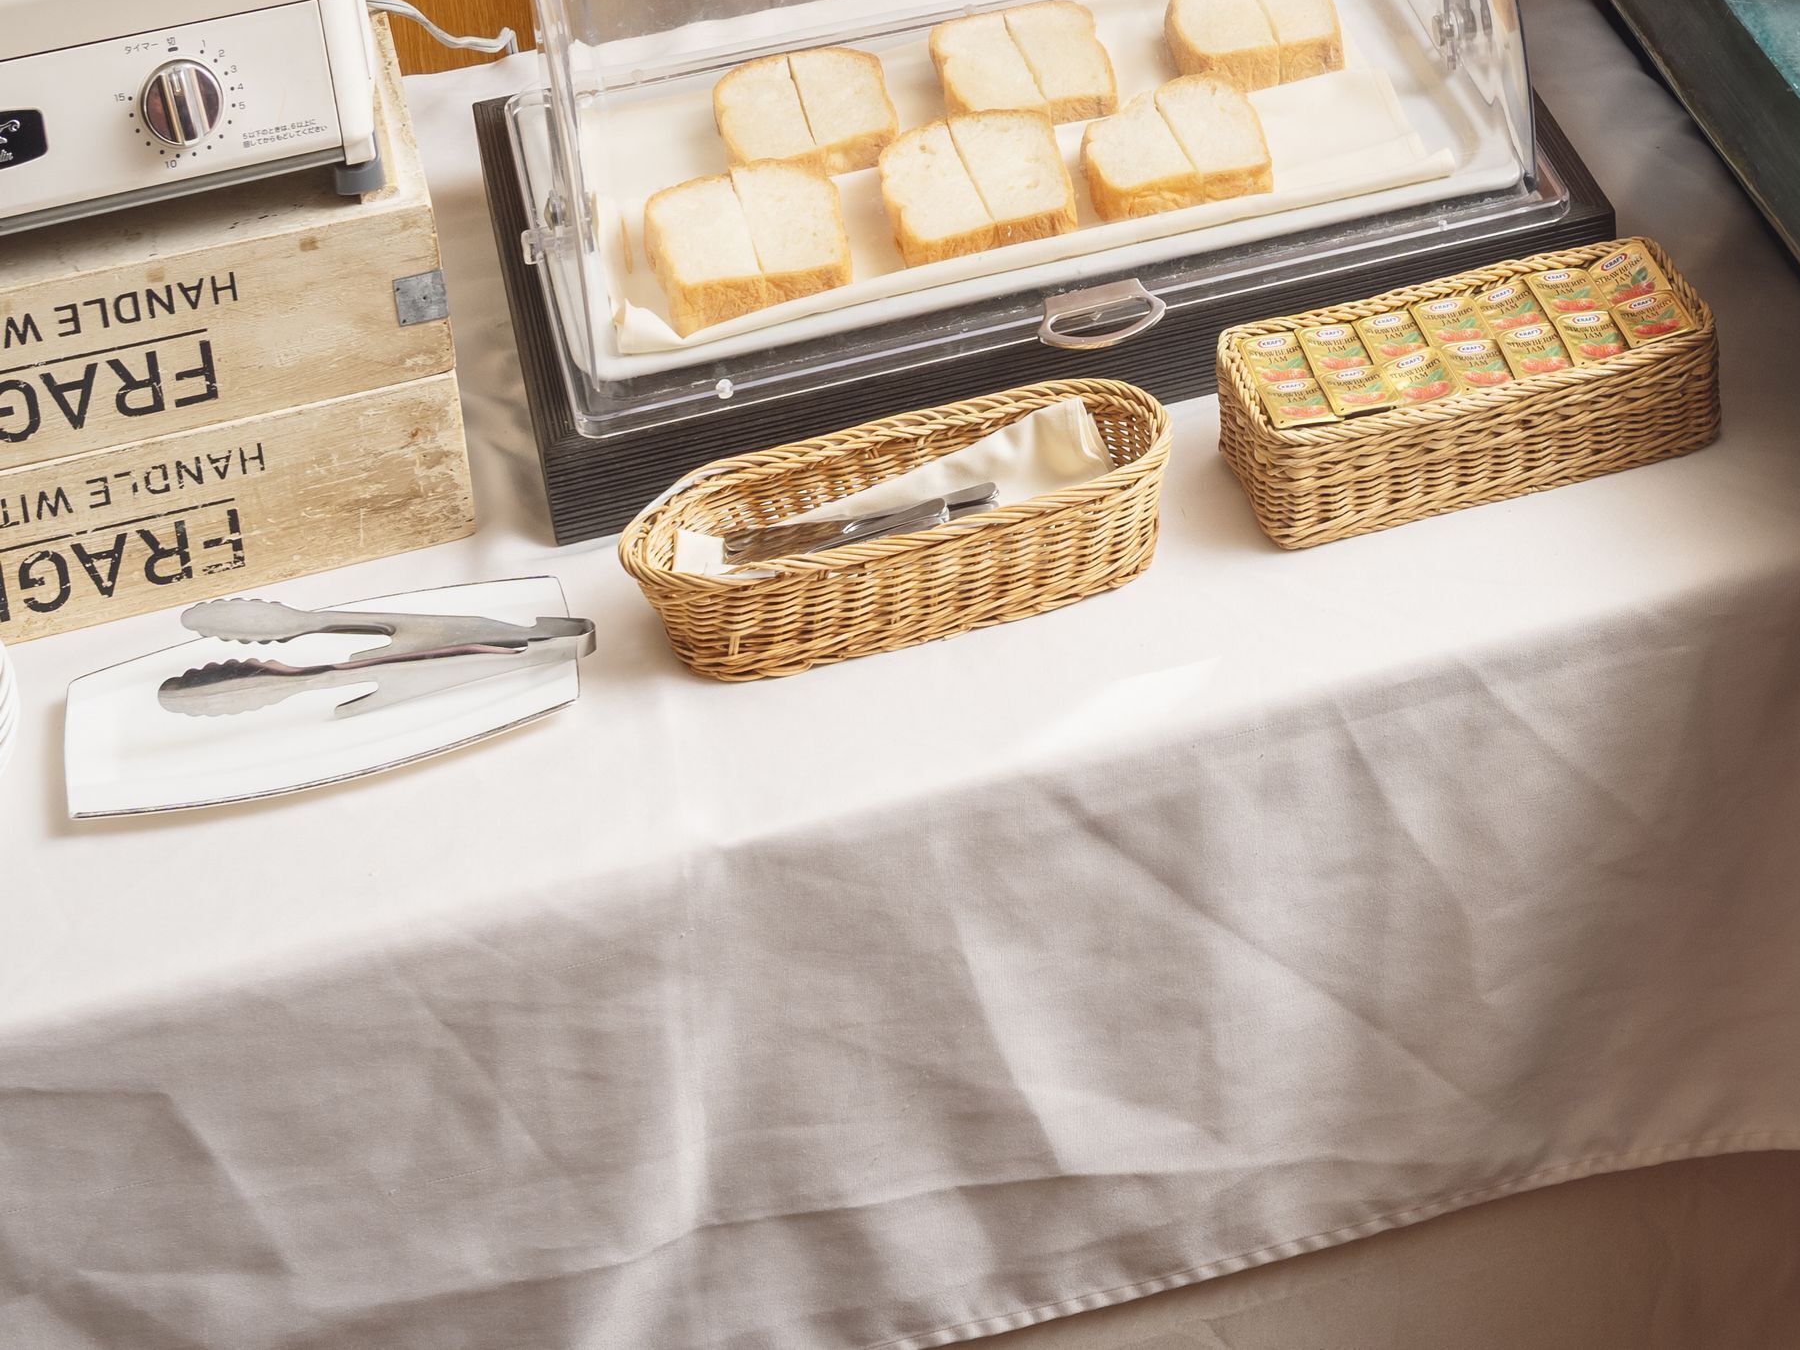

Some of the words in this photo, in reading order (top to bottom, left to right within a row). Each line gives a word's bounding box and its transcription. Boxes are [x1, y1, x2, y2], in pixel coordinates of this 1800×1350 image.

[166, 36, 176, 47] 切
[201, 39, 206, 48] 1
[124, 41, 160, 55] タイマー
[218, 49, 226, 58] 2
[230, 65, 238, 74] 3
[237, 82, 245, 91] 4
[114, 93, 126, 102] 15
[238, 101, 246, 110] 5
[164, 159, 178, 169] 10
[1604, 254, 1624, 271] KRAFT
[1613, 271, 1634, 285] JAM
[1491, 289, 1512, 300] KRAFT
[1554, 287, 1575, 296] JAM
[54, 271, 238, 338] HANDLE
[1633, 298, 1654, 308] KRAFT
[1499, 303, 1520, 315] JAM
[1640, 310, 1661, 321] JAM
[1376, 317, 1397, 325] KRAFT
[1441, 317, 1461, 326] JAM
[1384, 332, 1404, 340] JAM
[1519, 329, 1539, 337] KRAFT
[1583, 330, 1604, 339] JAM
[1261, 338, 1282, 346] KRAFT
[1327, 345, 1347, 353] JAM
[1525, 344, 1546, 354] JAM
[1268, 356, 1288, 364] JAM
[1401, 356, 1421, 367] KRAFT
[1468, 359, 1489, 367] JAM
[1408, 371, 1429, 383] JAM
[1346, 382, 1367, 391] JAM
[1287, 395, 1307, 403] JAM
[86, 442, 266, 510] HANDLE
